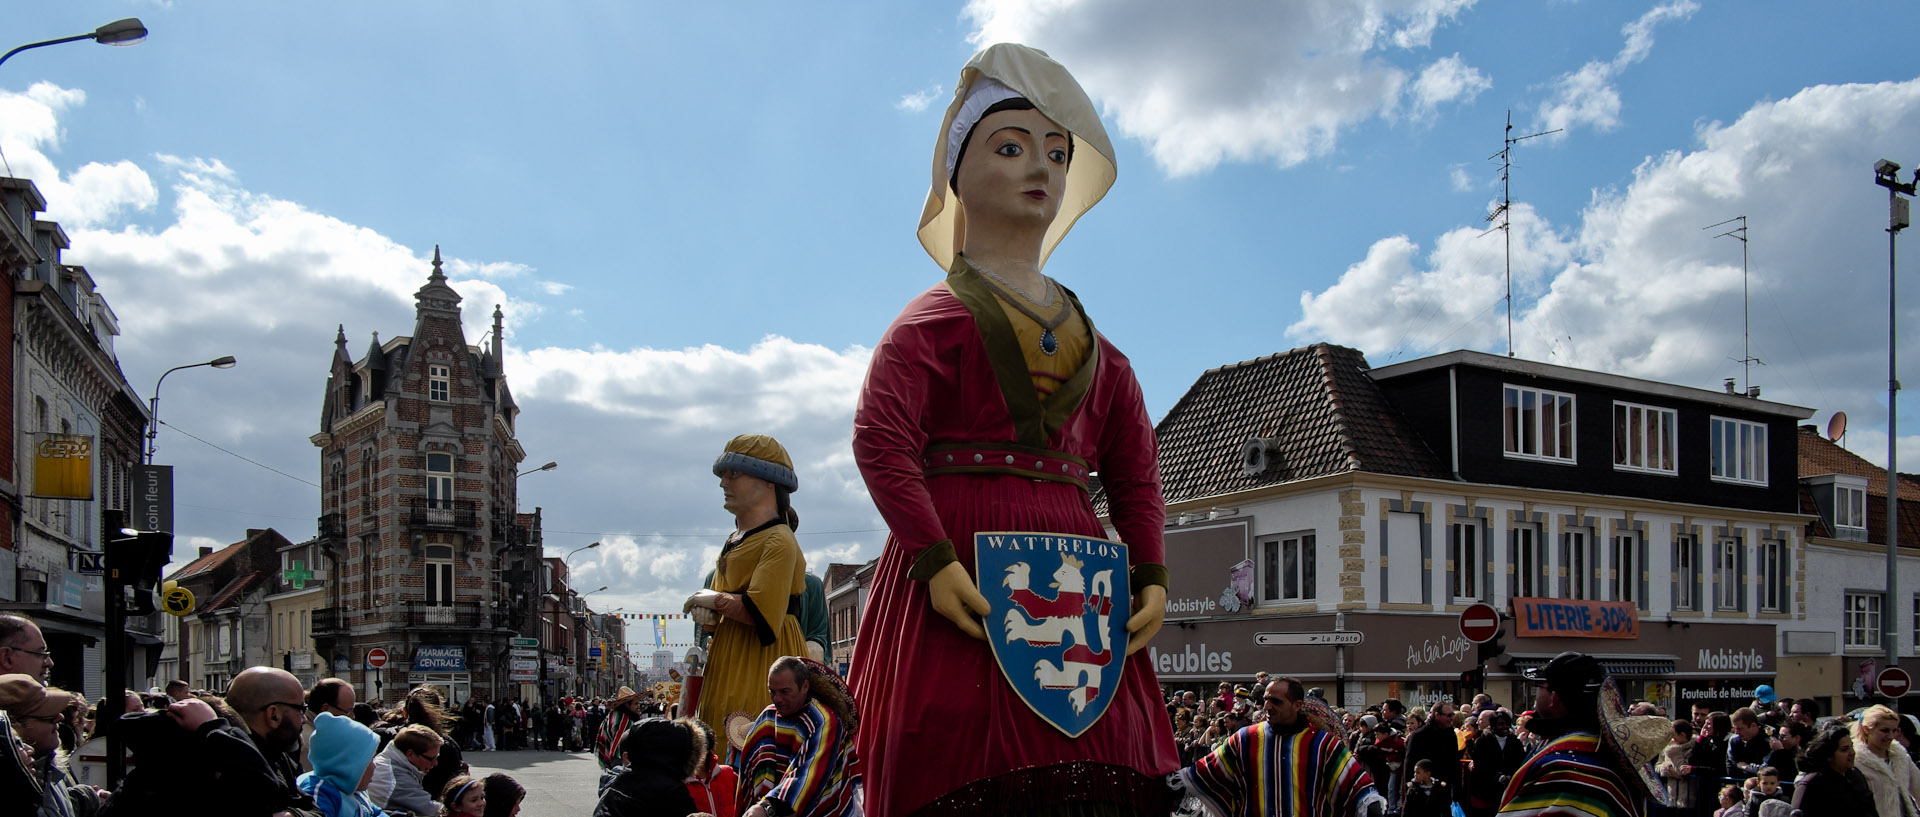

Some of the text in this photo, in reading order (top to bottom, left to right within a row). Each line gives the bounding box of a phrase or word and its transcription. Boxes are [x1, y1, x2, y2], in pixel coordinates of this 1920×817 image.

[146, 470, 158, 531] coin fleuri
[987, 535, 1119, 559] WATTRELOS
[1165, 596, 1216, 614] Mobistyle
[1525, 602, 1633, 633] LITERIE -30%
[1335, 634, 1358, 642] Poste
[416, 648, 463, 658] PHARMACIE
[1406, 635, 1471, 669] Au Gai Logis
[419, 658, 460, 668] CENTRALE
[1697, 647, 1763, 676] Mobistyle
[1409, 689, 1454, 704] Meubles
[1681, 687, 1718, 699] Fauteuils
[1718, 687, 1730, 699] de
